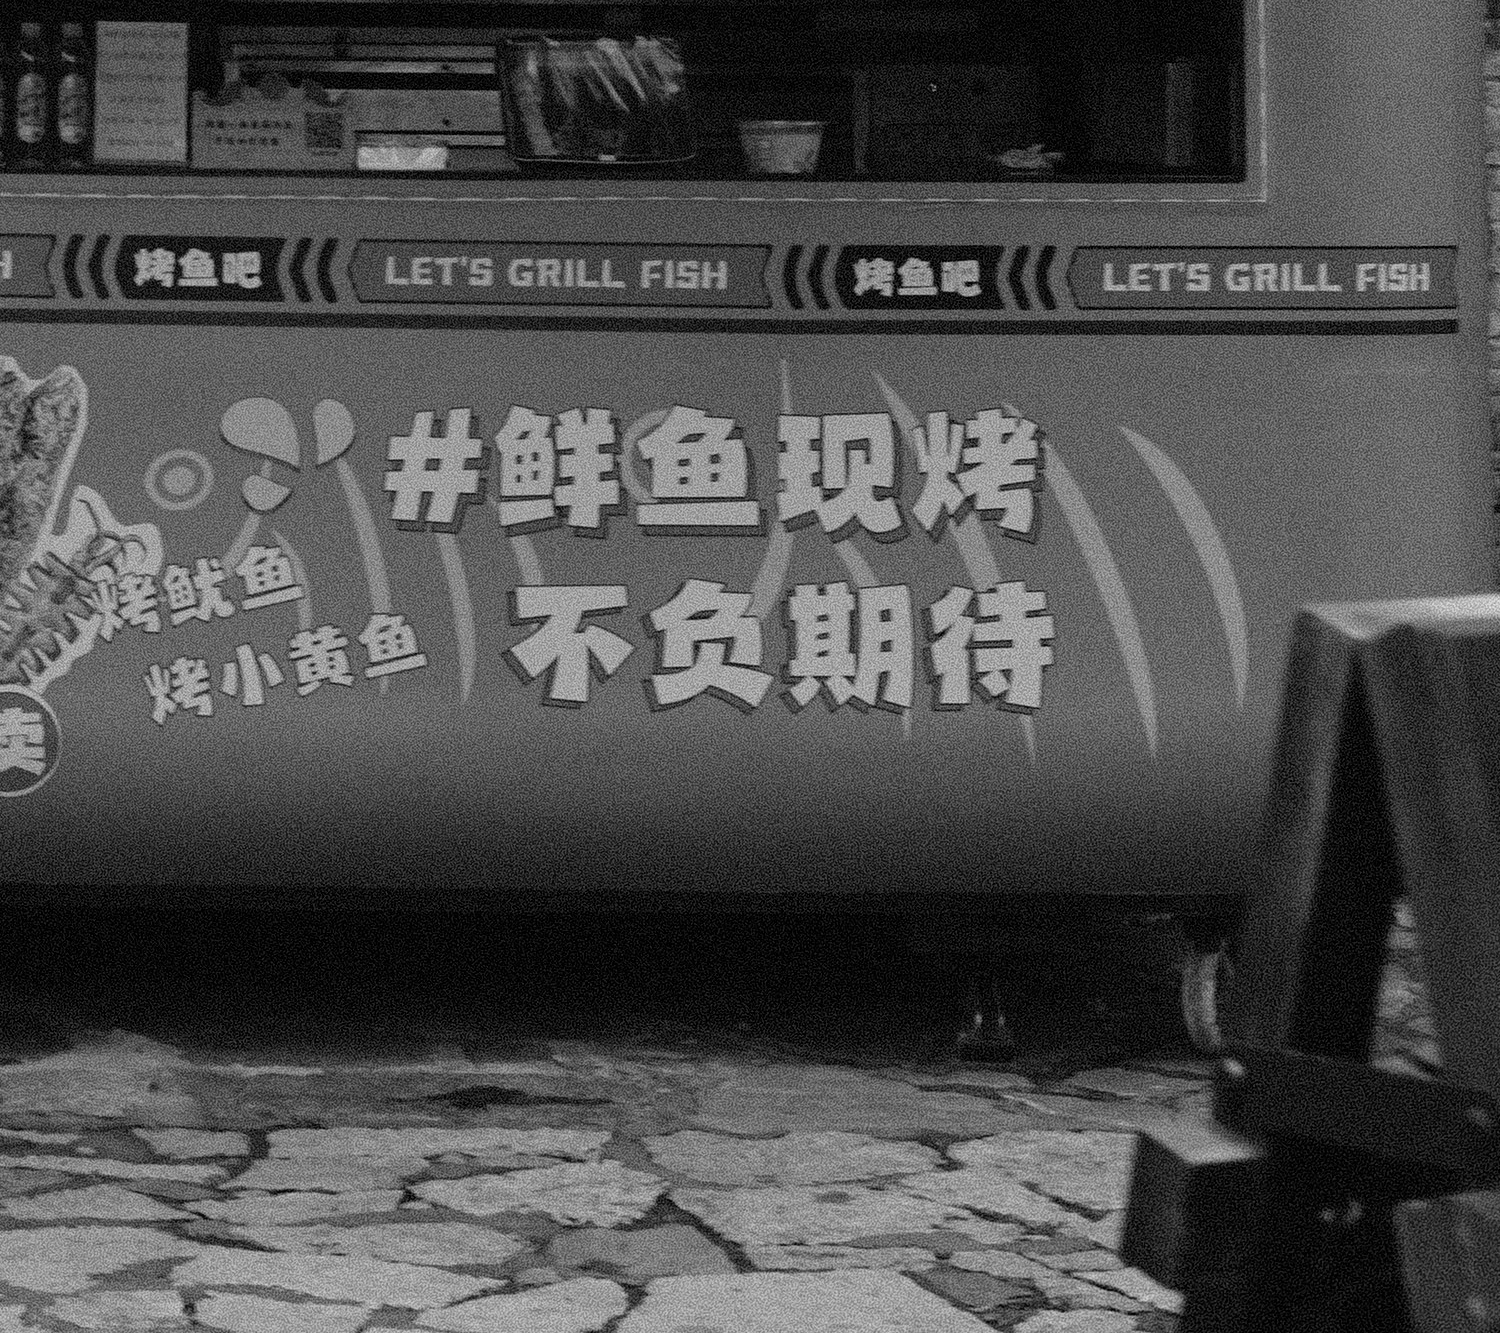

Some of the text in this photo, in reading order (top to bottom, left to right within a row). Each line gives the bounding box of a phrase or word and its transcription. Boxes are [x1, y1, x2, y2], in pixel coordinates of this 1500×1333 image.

[134, 248, 262, 289] 烤鱼吧
[384, 255, 729, 291] LET'S GRILL FISH
[854, 258, 981, 296] 烤鱼吧
[1102, 261, 1432, 293] LET'S GRILL FISH
[89, 545, 304, 643] 烤鱿鱼
[503, 578, 1056, 713] 不负期待
[144, 614, 428, 727] 烤小黄鱼
